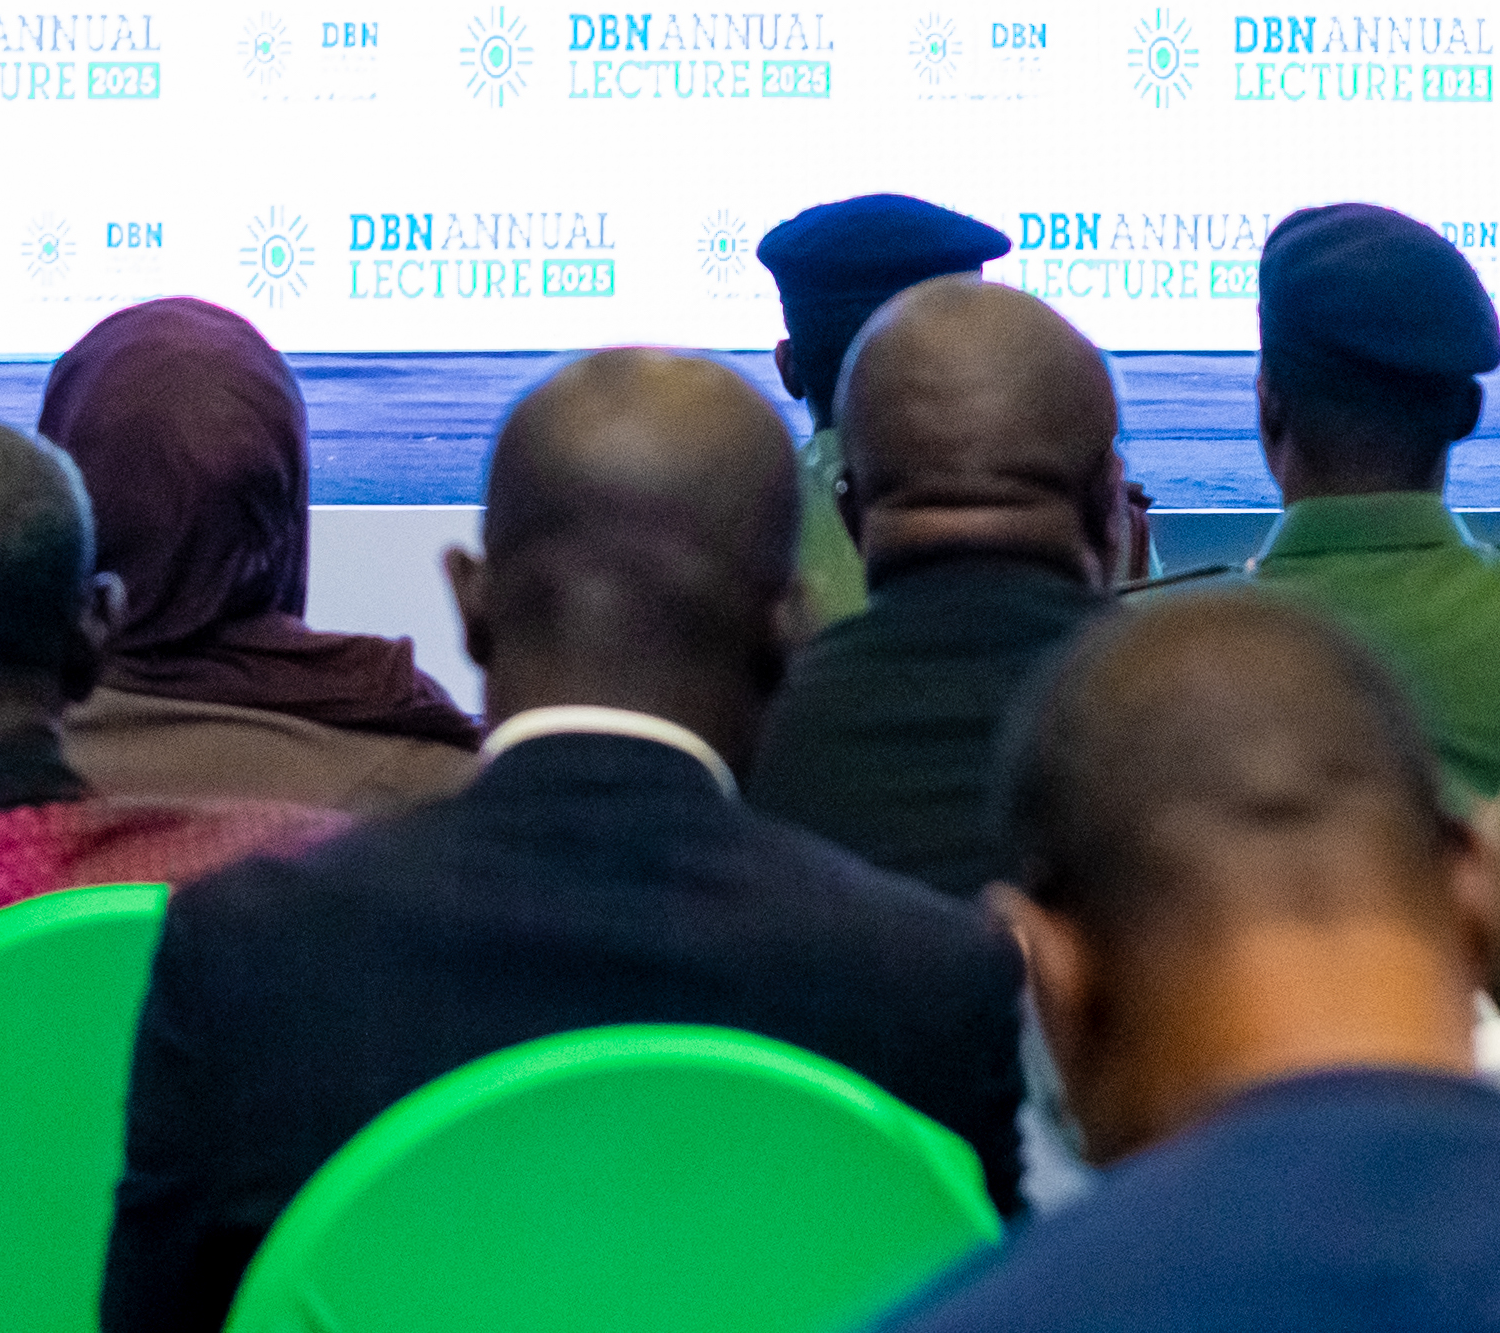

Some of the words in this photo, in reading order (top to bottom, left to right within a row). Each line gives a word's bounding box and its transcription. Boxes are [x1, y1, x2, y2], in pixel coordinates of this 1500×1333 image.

[322, 22, 378, 48] DBN
[569, 13, 652, 52] DBN
[660, 14, 833, 50] ANNUAL
[992, 23, 1046, 49] DBN
[1234, 16, 1317, 54] DBN
[1322, 17, 1493, 54] ANNUAL
[90, 67, 157, 95] 2025
[569, 60, 749, 98] LECTURE
[1235, 61, 1412, 101] LECTURE
[107, 222, 163, 248] DBN
[349, 213, 433, 251] DBN
[441, 213, 615, 250] ANNUAL
[1019, 212, 1101, 250] DBN
[350, 259, 531, 298] LECTURE
[1019, 259, 1198, 298] LECTURE
[1212, 265, 1259, 294] 202
